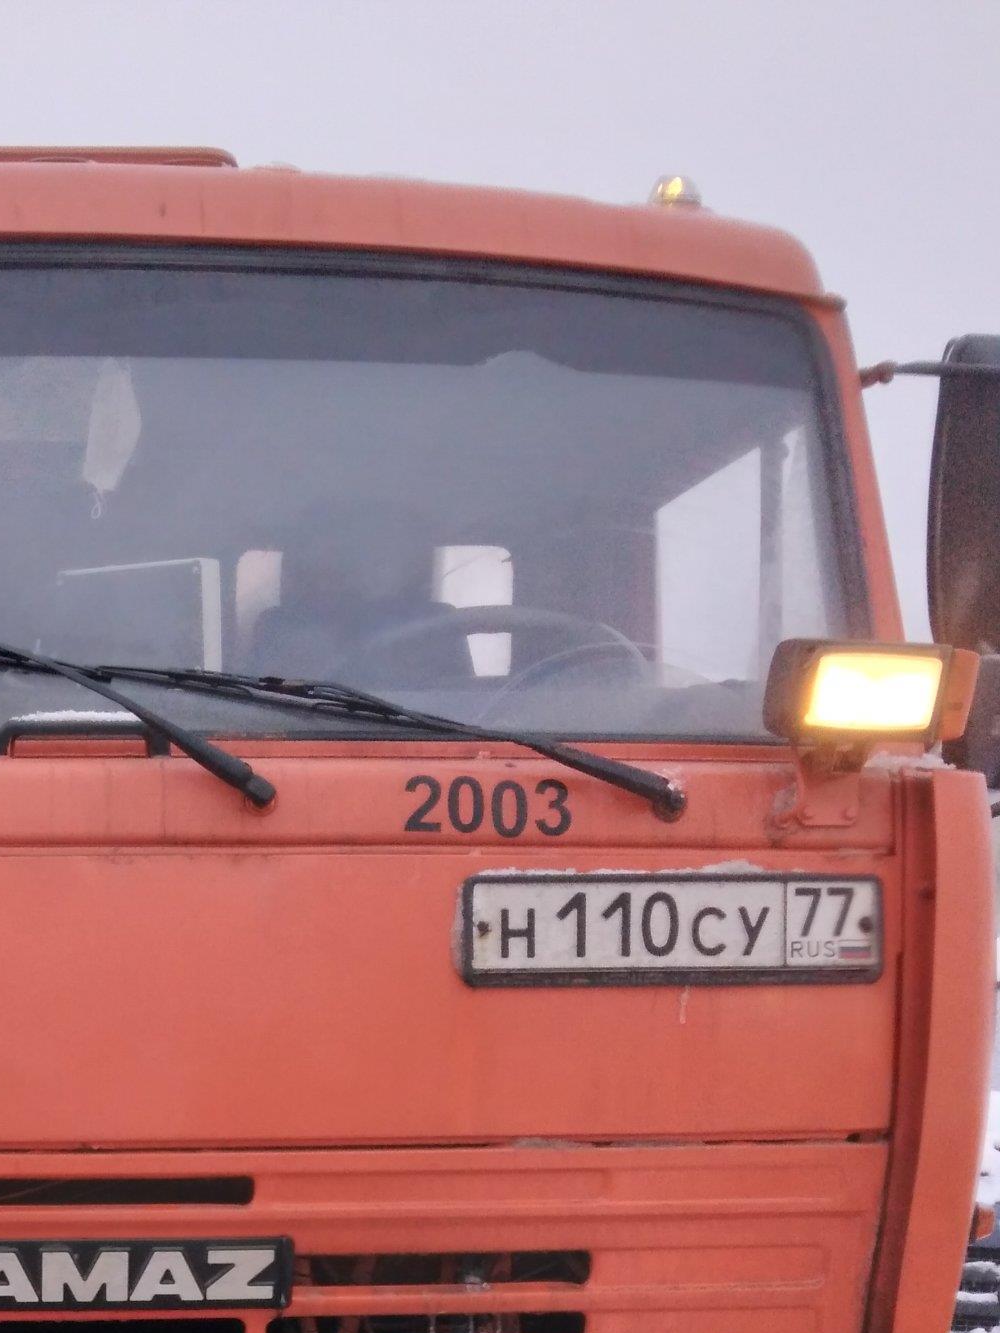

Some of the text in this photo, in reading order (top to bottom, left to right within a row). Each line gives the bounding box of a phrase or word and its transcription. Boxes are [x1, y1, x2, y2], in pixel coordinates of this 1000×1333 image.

[404, 775, 572, 838] 2003
[794, 887, 856, 937] 77
[791, 941, 836, 958] RUS
